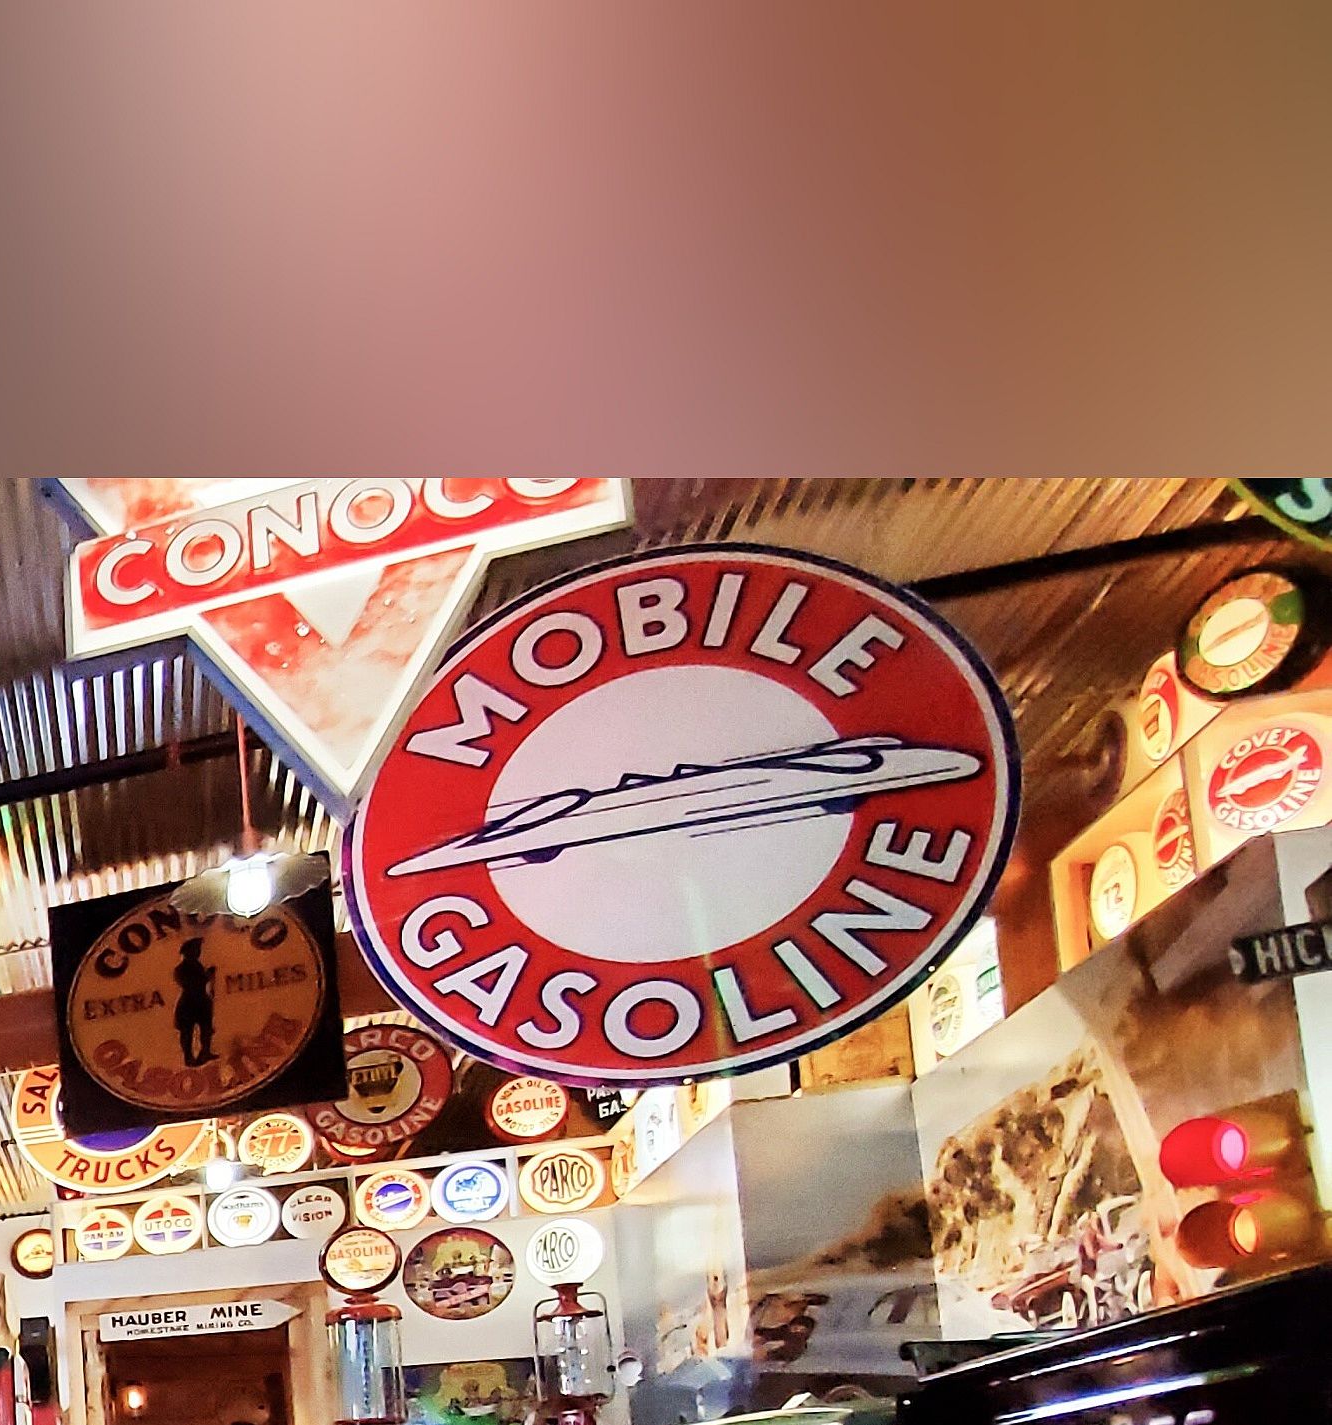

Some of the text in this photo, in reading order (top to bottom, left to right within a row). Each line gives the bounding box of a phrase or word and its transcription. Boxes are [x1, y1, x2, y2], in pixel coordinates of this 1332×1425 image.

[405, 573, 905, 768] MOBILE
[1221, 728, 1300, 769] COVEY
[1215, 768, 1320, 829] GASOLINE
[95, 905, 289, 978] CONO
[400, 822, 970, 1059] GASOLINE
[84, 964, 307, 1020] EXTRA MILES
[23, 1066, 59, 1115] SAL
[496, 1096, 562, 1117] GASOLINE
[315, 1097, 443, 1145] GASOLINE
[55, 1139, 176, 1184] TRUCKS
[540, 1158, 588, 1199] PARCO
[83, 1230, 125, 1241] PAN-AM
[145, 1217, 192, 1232] UTOCO
[292, 1210, 333, 1222] VISION
[329, 1244, 391, 1260] GASOLINE
[535, 1231, 575, 1269] PARCO
[111, 1303, 263, 1329] HAUBER MINE
